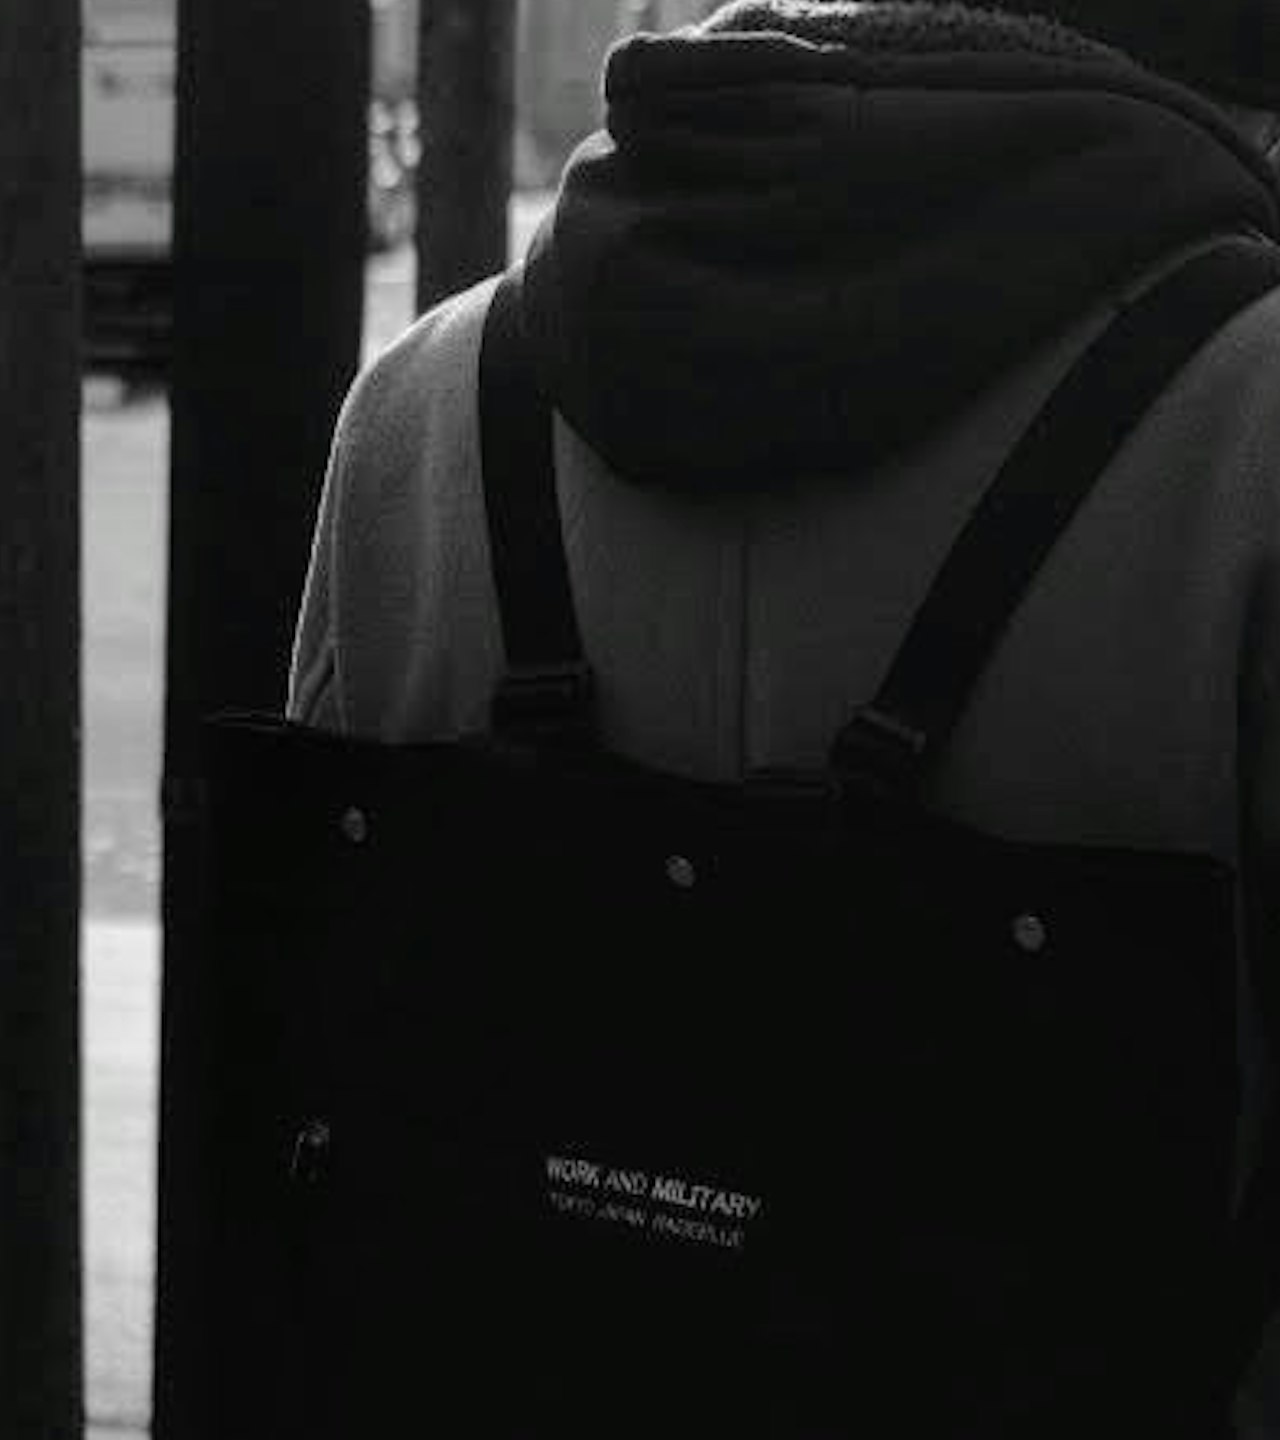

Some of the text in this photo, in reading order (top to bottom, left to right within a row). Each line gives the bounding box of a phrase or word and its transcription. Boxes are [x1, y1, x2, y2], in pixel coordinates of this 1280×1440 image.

[547, 1156, 763, 1219] WORK AND MILITARY
